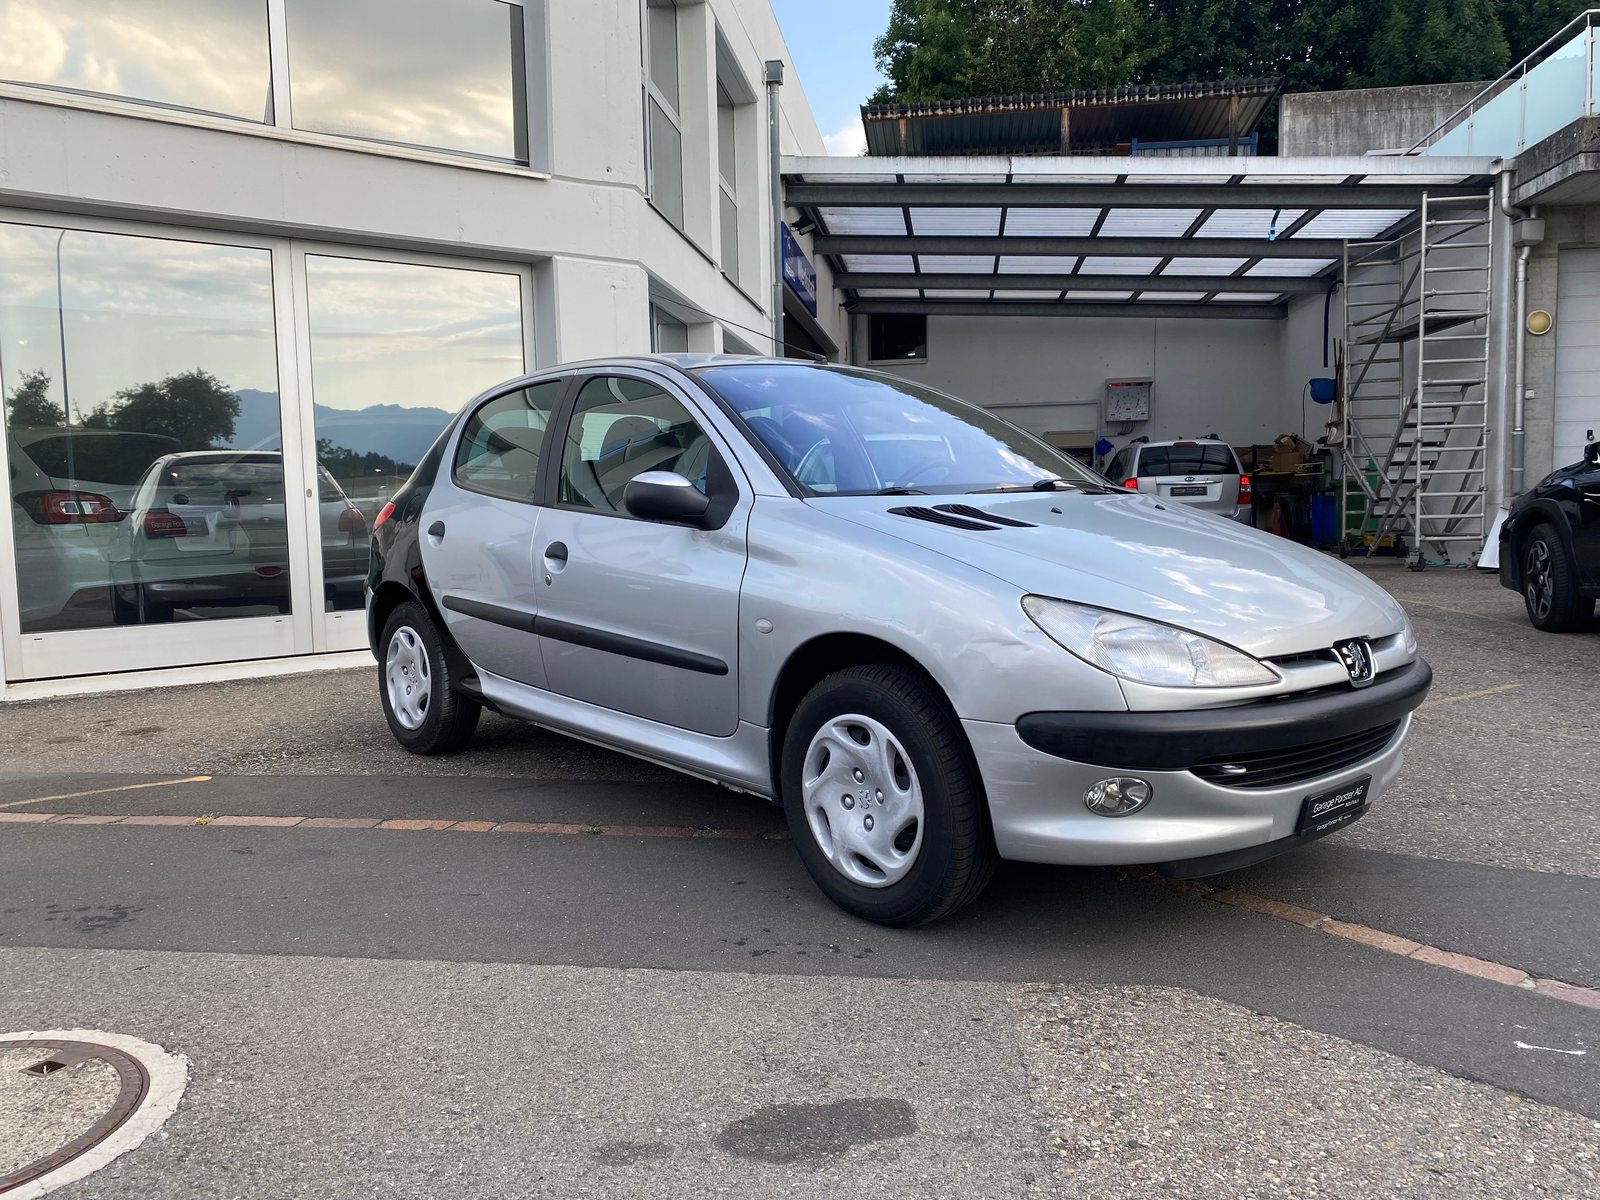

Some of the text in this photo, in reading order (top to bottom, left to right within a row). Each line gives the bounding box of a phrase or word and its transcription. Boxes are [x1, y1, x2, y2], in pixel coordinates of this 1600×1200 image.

[1313, 785, 1364, 813] Garage Forster AG
